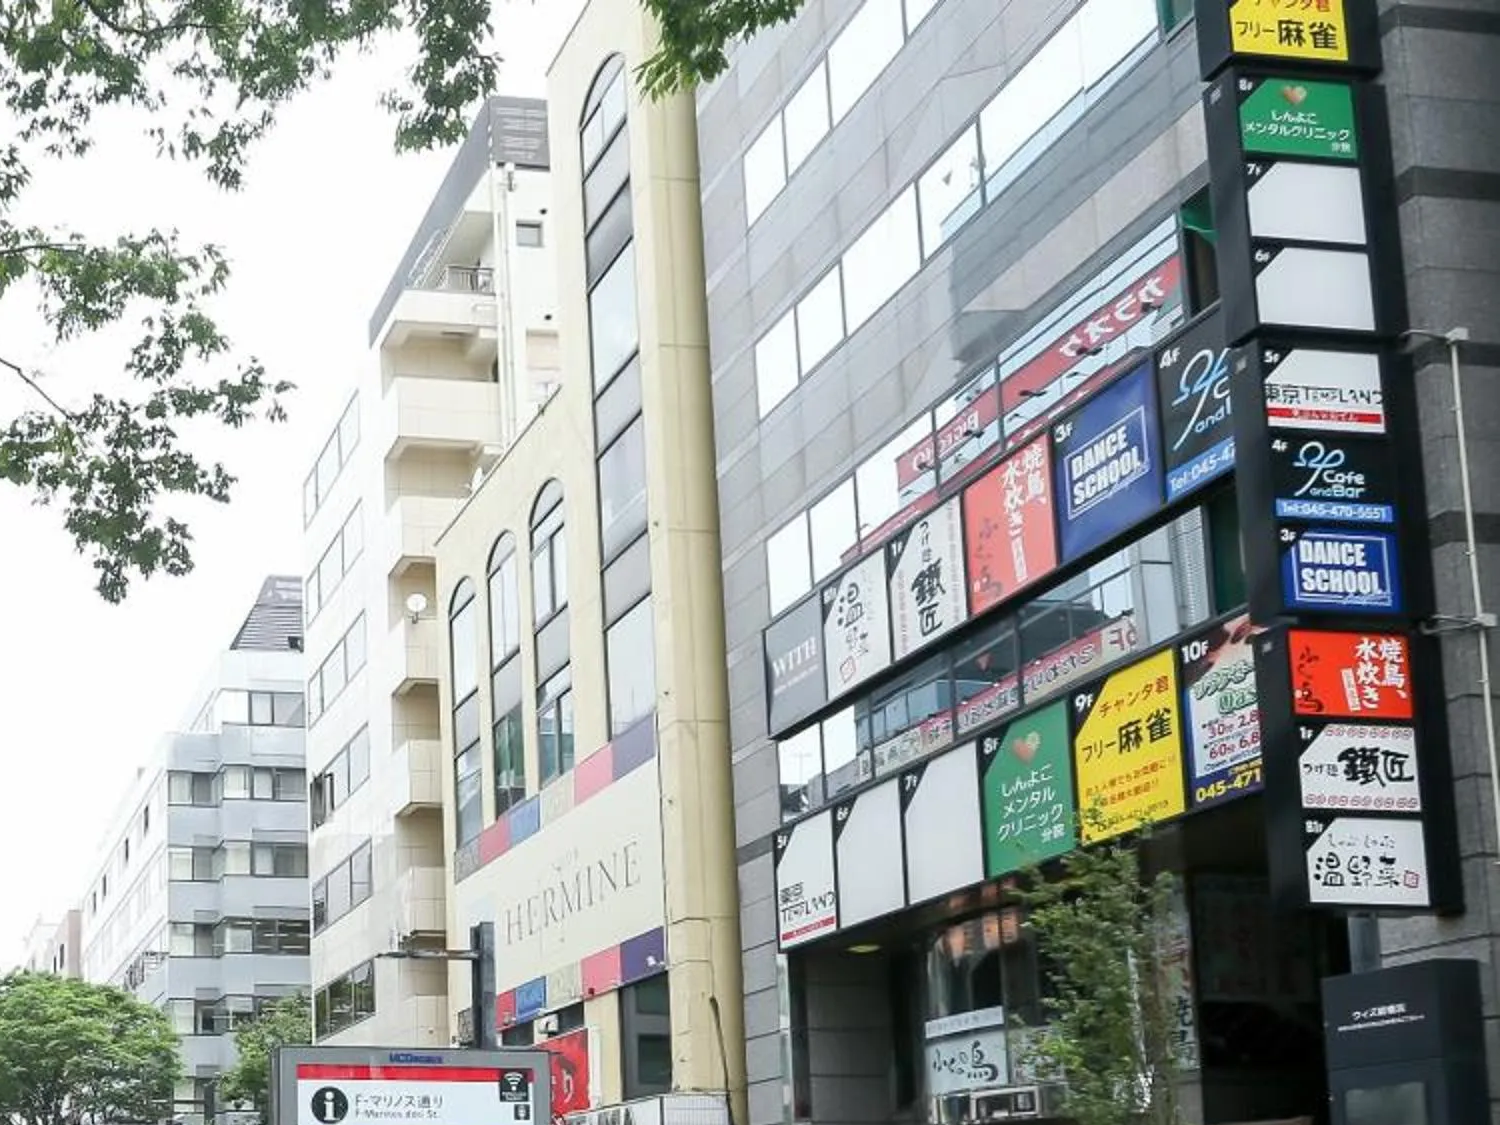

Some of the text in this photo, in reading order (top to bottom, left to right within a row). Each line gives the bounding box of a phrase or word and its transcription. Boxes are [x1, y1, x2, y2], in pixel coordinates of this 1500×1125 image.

[1236, 19, 1338, 50] フリー麻雀
[1244, 122, 1350, 142] メンタルクリニック
[1054, 422, 1074, 443] 3F
[1272, 439, 1288, 452] 4F
[1071, 425, 1129, 481] DANCE
[1073, 446, 1142, 506] SCHOOL
[1323, 469, 1365, 484] Cafe
[1280, 529, 1296, 541] 3F
[1300, 540, 1367, 566] DANCE
[1301, 569, 1381, 595] SCHOOL
[1182, 640, 1208, 663] 10F
[1075, 693, 1093, 713] 9F
[1082, 707, 1173, 764] フリー麻雀
[1196, 769, 1263, 803] 045-471
[1003, 787, 1056, 819] メンタル
[997, 803, 1064, 842] クリニック
[505, 841, 641, 945] HERMINE
[355, 1095, 443, 1109] F-マリノス通り
